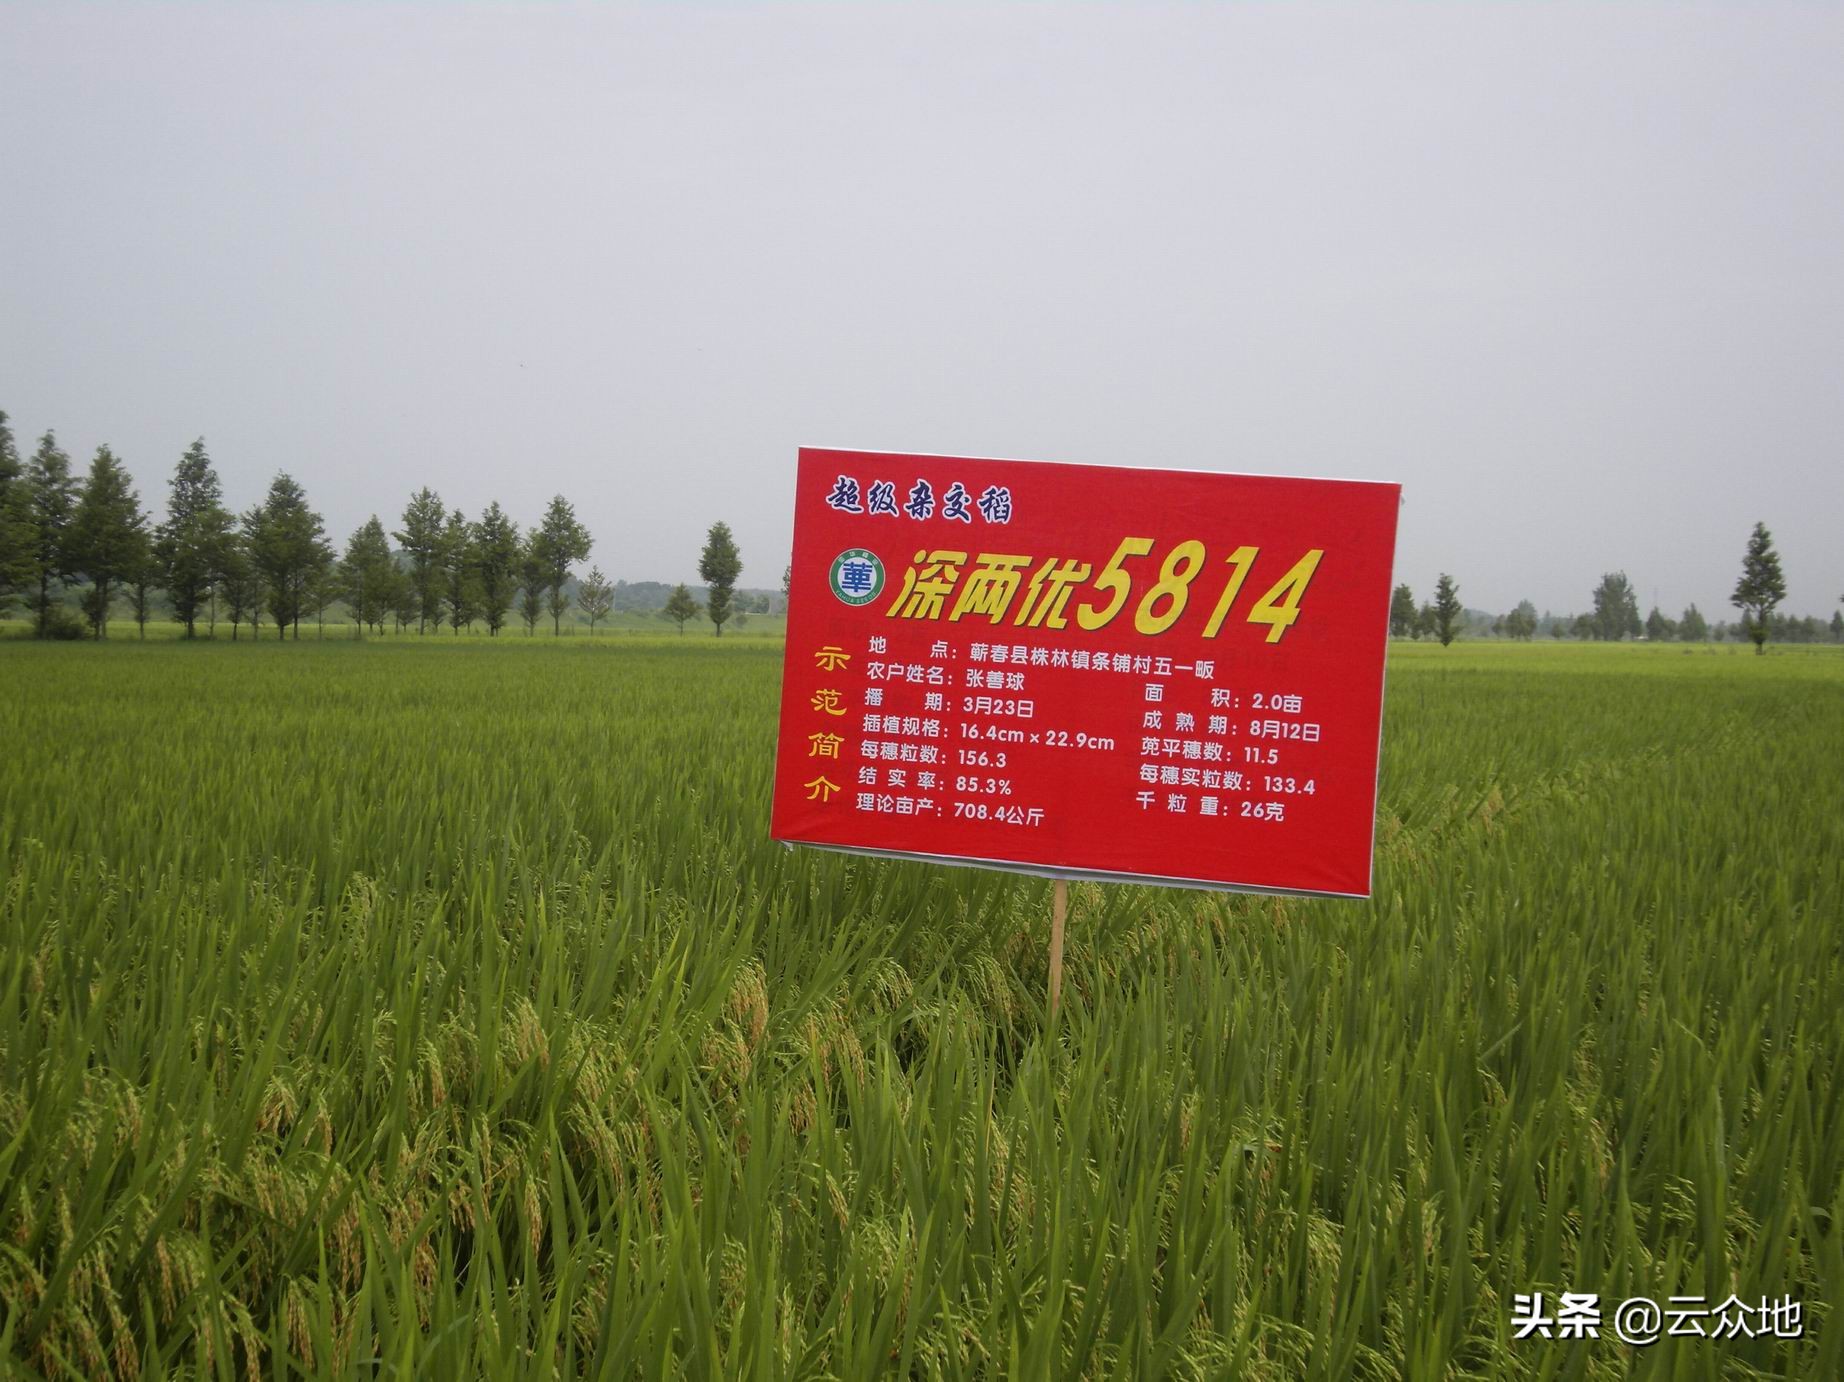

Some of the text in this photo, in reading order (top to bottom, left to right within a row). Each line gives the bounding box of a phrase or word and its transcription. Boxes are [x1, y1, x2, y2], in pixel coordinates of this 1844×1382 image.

[825, 474, 1014, 525] 超级杂交稻
[885, 536, 1326, 644] 深两优5814
[803, 645, 852, 804] 示范简介
